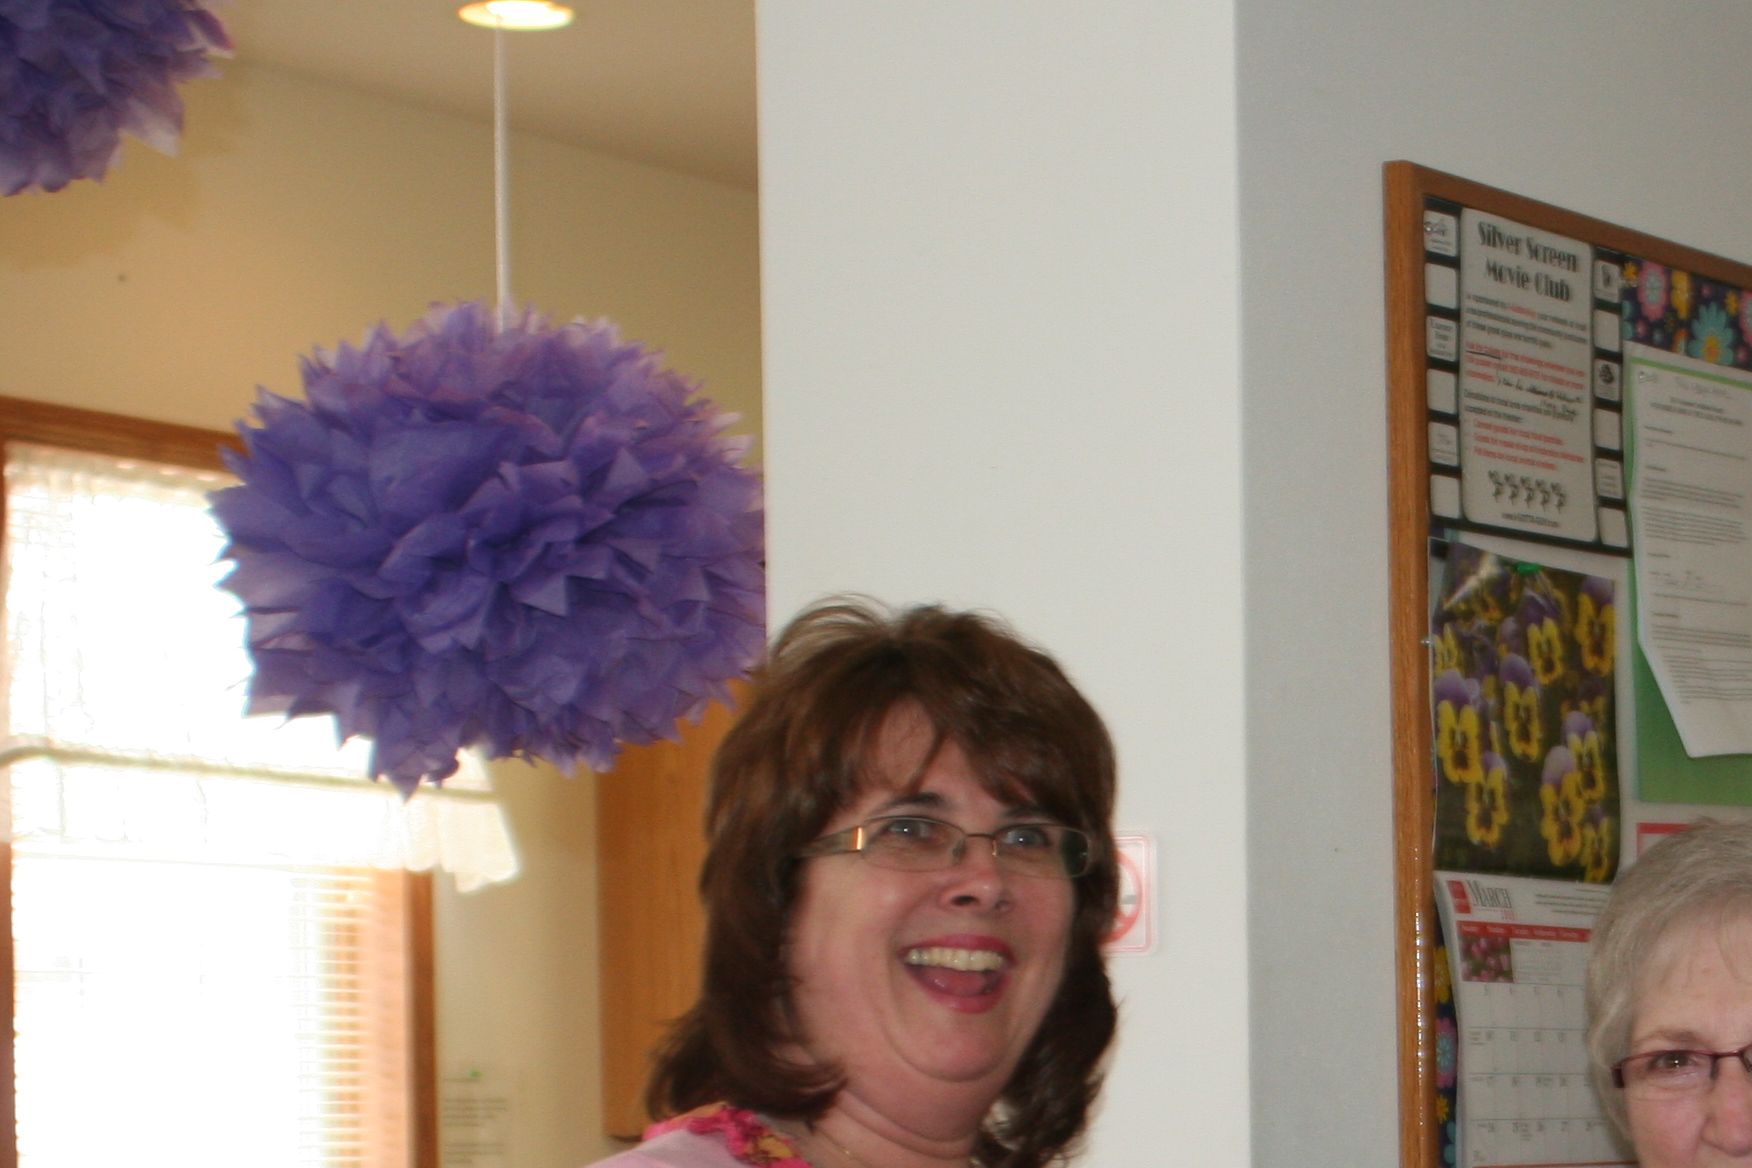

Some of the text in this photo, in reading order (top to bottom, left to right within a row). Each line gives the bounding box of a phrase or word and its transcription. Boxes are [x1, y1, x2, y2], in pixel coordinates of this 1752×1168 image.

[1477, 221, 1522, 255] Silver
[1526, 237, 1578, 272] Screen
[1485, 257, 1570, 302] Movie Club
